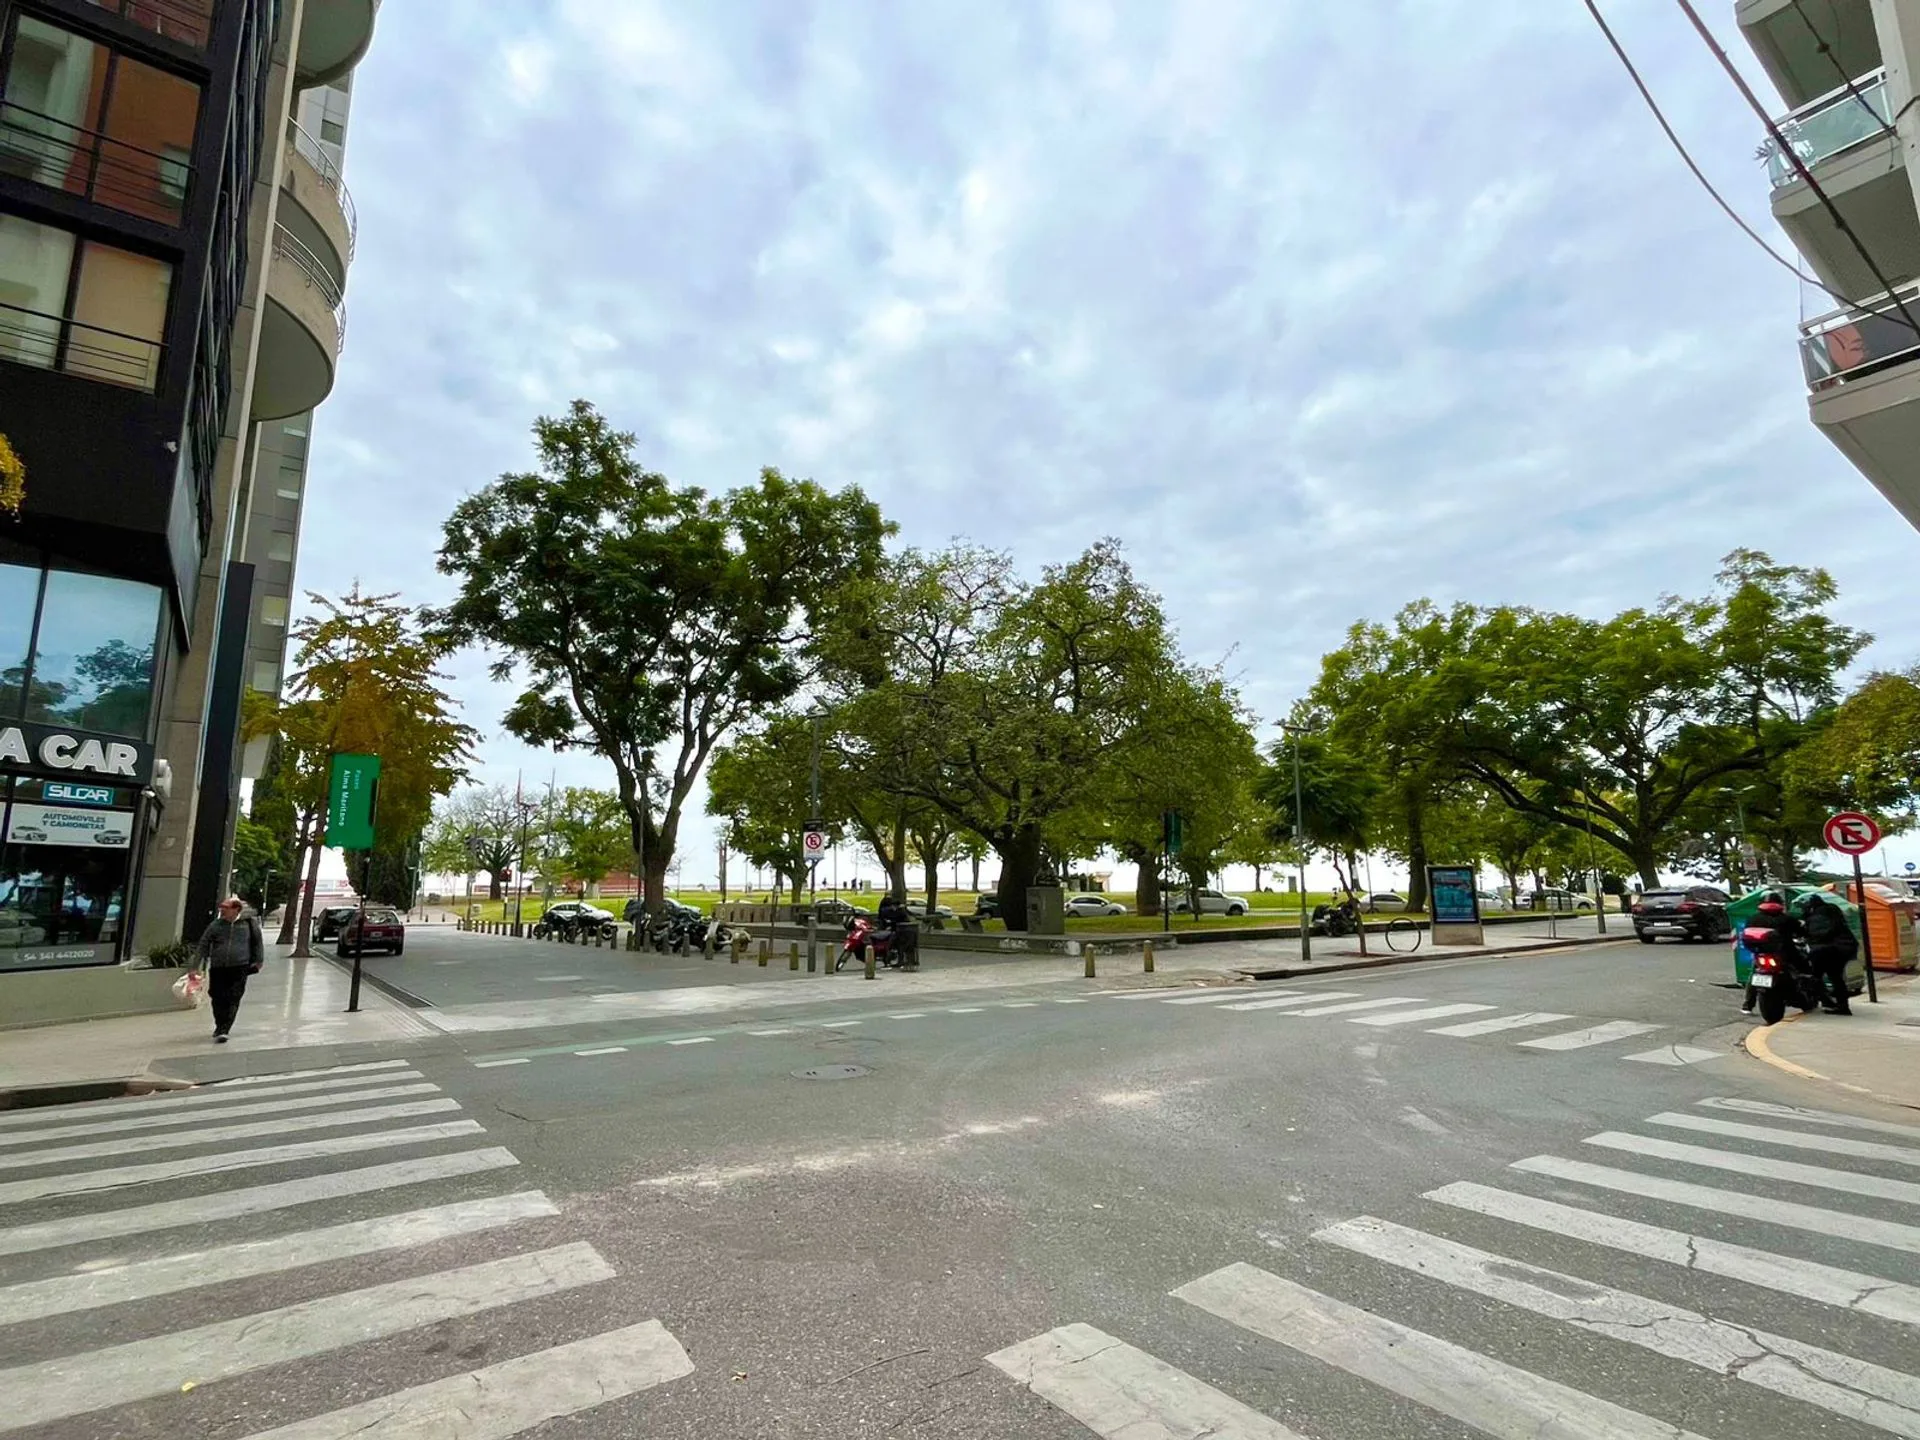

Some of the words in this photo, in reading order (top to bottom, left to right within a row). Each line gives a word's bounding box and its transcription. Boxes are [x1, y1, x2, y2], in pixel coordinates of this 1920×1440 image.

[0, 727, 31, 763] A
[39, 734, 138, 776] CAR
[342, 769, 351, 789] Alma
[48, 784, 110, 802] SILCAR
[43, 812, 106, 823] AUTOMOVILES
[50, 820, 105, 831] CAMIONETAS
